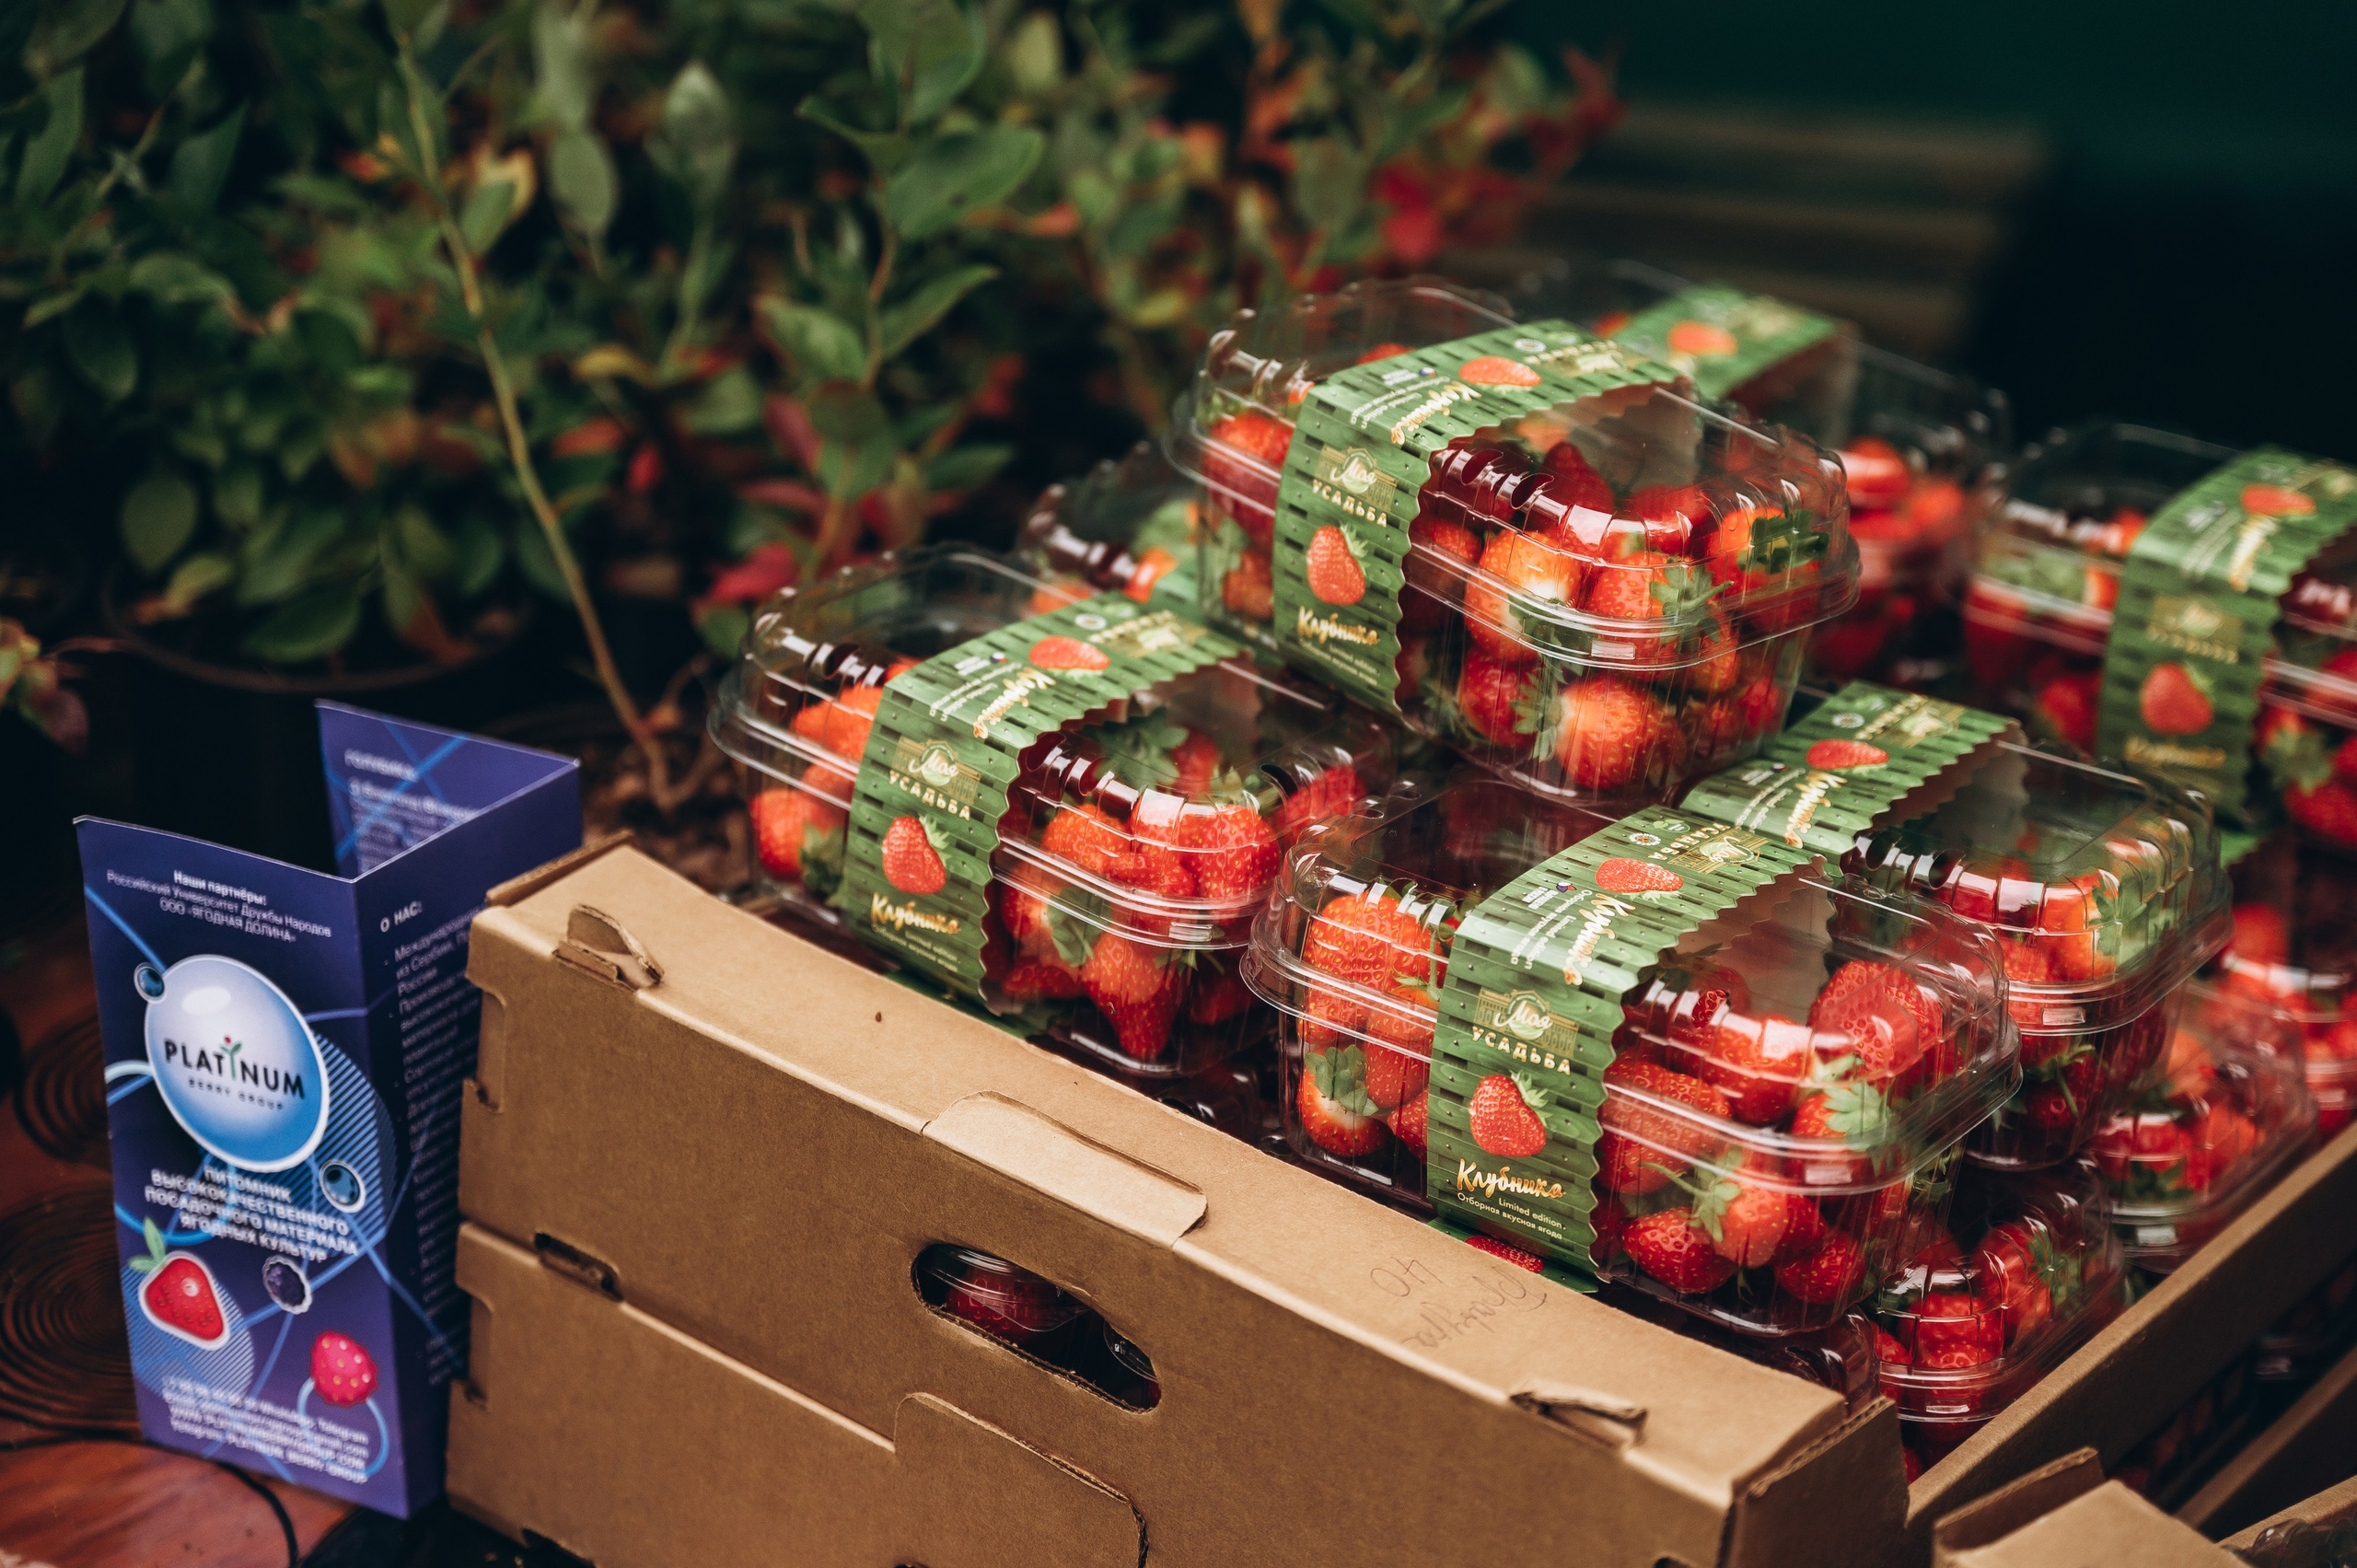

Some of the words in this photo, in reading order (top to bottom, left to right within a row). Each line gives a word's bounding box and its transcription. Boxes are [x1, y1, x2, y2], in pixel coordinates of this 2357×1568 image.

[1312, 479, 1387, 528] УСАДЬБА
[1297, 605, 1378, 645] Клубника
[908, 749, 959, 777] Моя
[889, 770, 970, 821] УСАДЬБА
[1648, 821, 1732, 861] УСАДЬБА
[174, 869, 206, 891] Наши
[107, 868, 170, 897] Российский
[172, 885, 239, 913] Университет
[241, 902, 284, 925] Дружбы
[284, 913, 332, 938] Народов
[159, 896, 185, 915] ООО
[871, 892, 958, 935] Клубника
[1562, 893, 1636, 986] Клубника
[1494, 1000, 1552, 1029] Моя
[163, 1036, 306, 1099] PLATINUM
[1472, 1026, 1571, 1075] УСАДЬБА
[188, 1077, 230, 1095] BERRY
[238, 1090, 284, 1109] GROUP
[204, 1166, 292, 1203] ПИТОМНИК
[1457, 1158, 1563, 1199] Клубника
[1457, 1192, 1500, 1214] Отборная
[1502, 1212, 1536, 1229] вкусная
[1538, 1225, 1562, 1240] ягода
[1498, 1198, 1529, 1216] Limited
[264, 1218, 358, 1256] МАТЕРИАЛА
